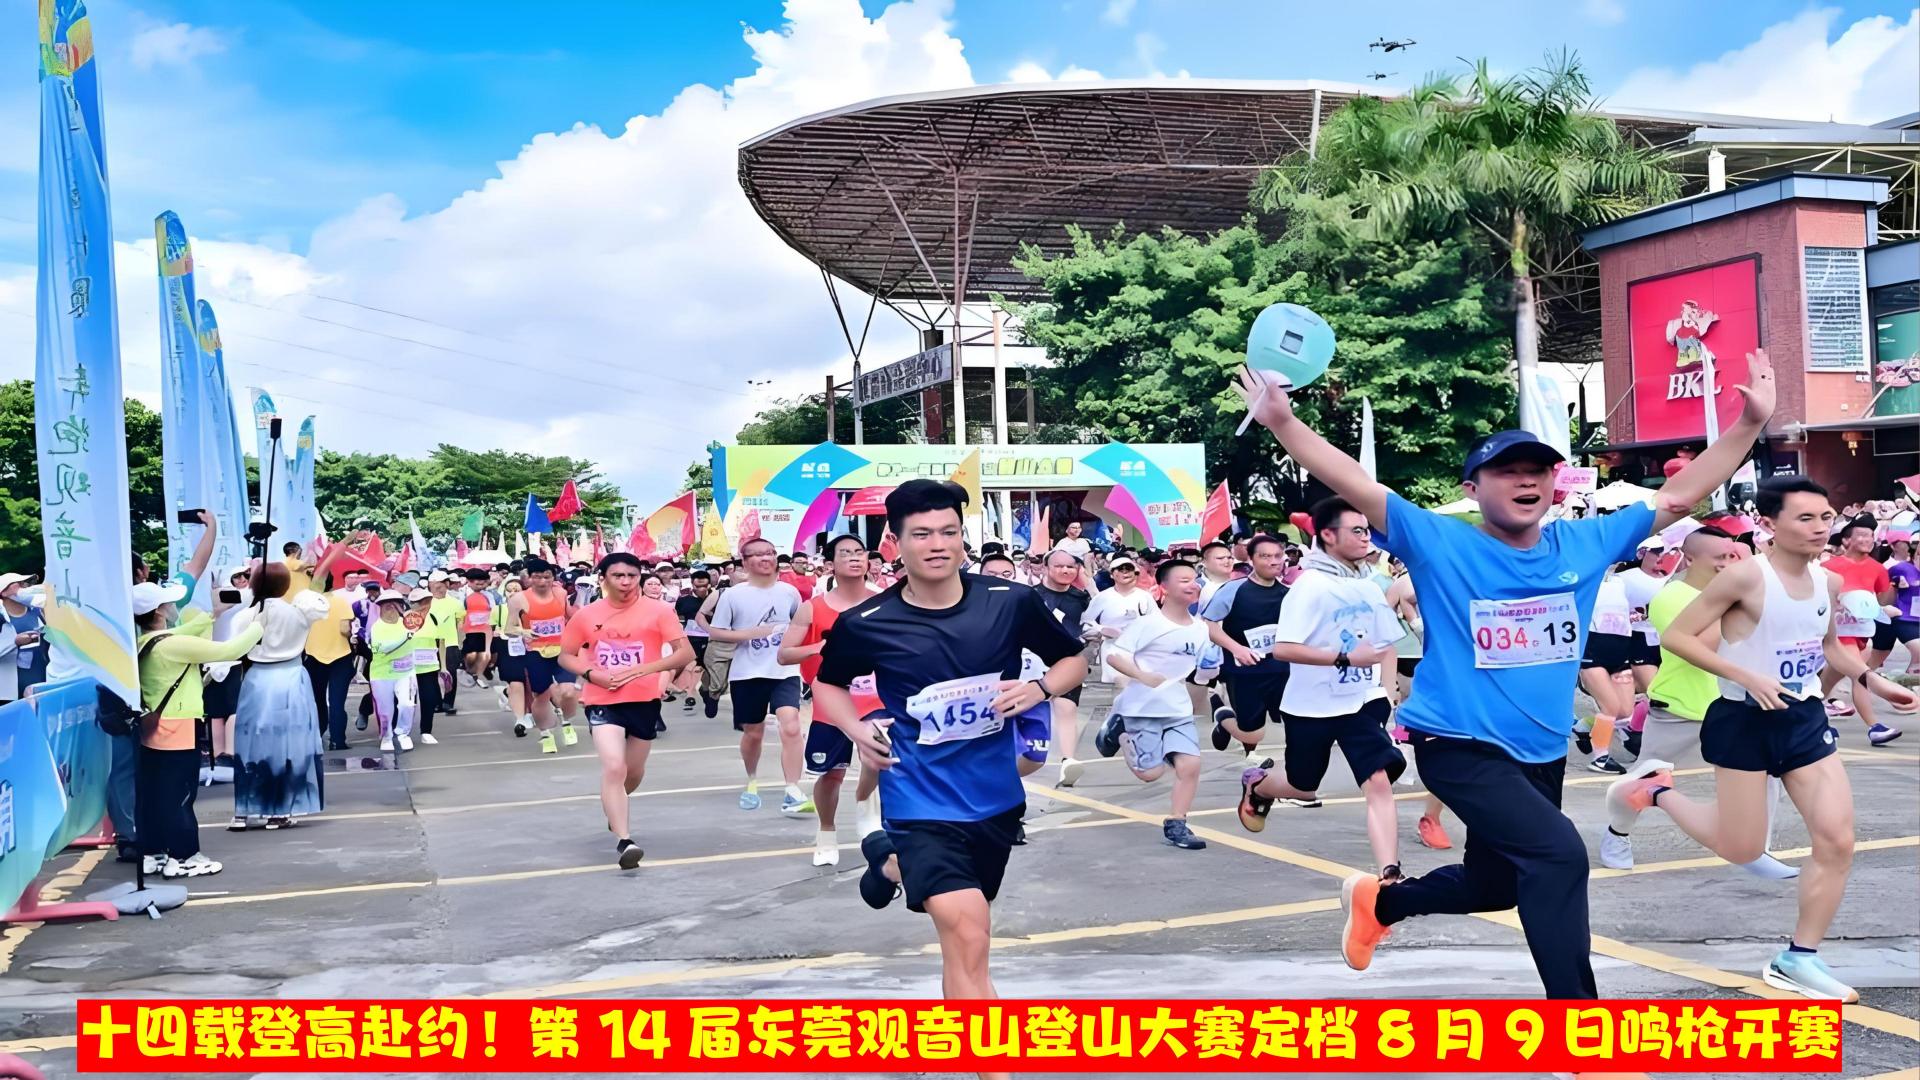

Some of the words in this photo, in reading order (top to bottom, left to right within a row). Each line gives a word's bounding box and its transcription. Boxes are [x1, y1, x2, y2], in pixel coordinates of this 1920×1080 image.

[1476, 627, 1528, 650] 034
[1543, 620, 1577, 646] 13
[923, 699, 995, 733] 1454
